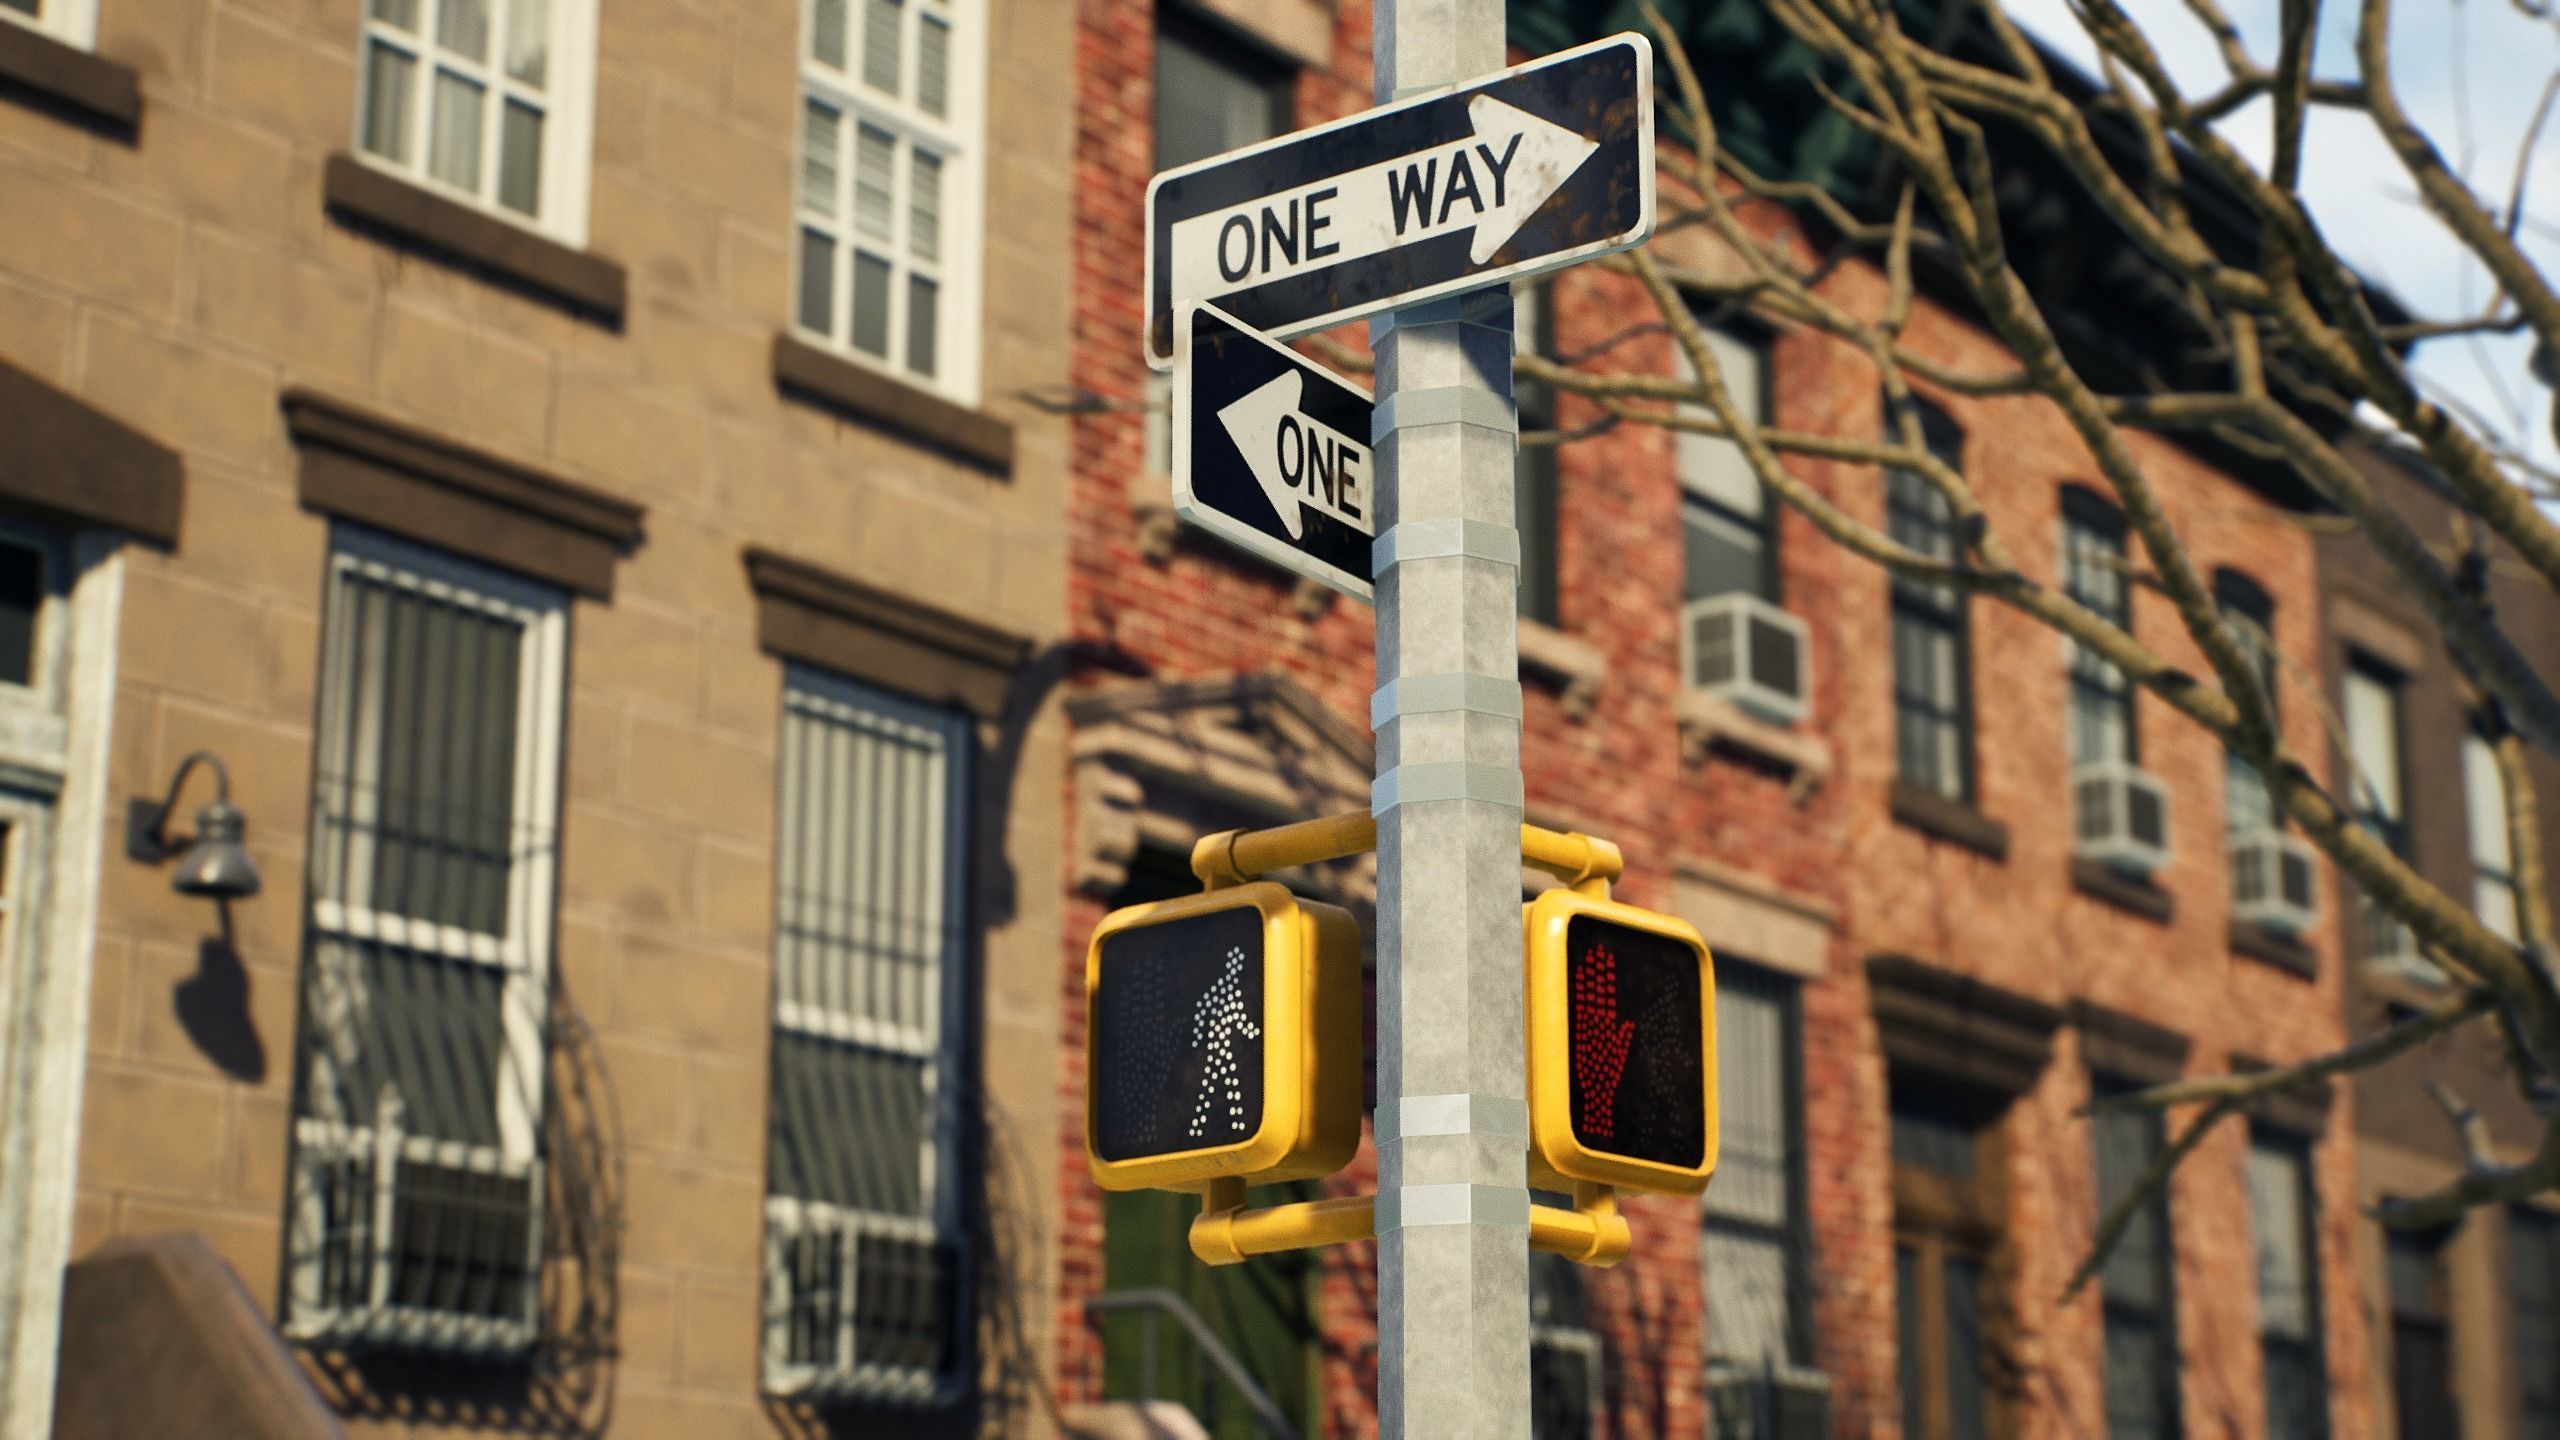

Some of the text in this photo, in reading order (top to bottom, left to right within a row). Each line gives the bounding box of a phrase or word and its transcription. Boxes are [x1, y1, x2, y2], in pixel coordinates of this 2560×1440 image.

[1218, 132, 1524, 283] ONE WAY
[1277, 414, 1361, 520] ONE
